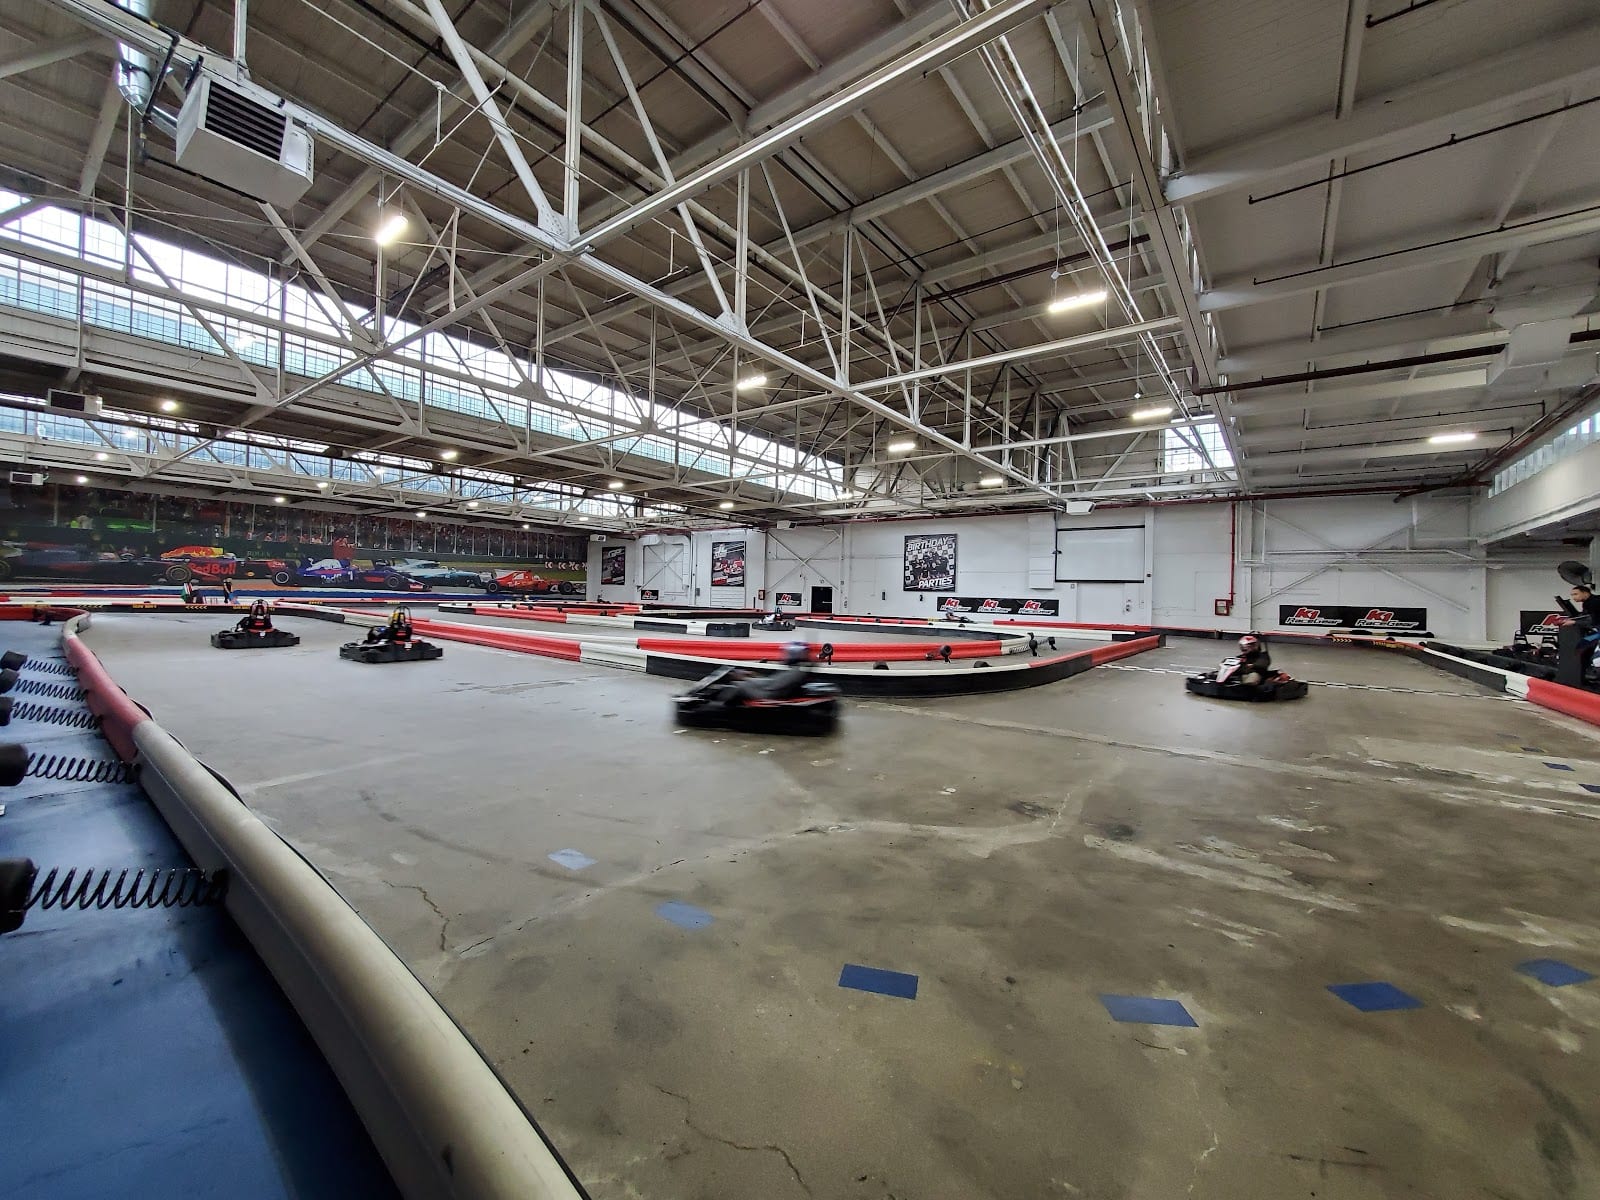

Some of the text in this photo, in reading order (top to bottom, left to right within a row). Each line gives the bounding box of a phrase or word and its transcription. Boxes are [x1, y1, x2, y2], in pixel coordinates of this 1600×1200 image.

[907, 537, 949, 551] BIRTHDAY
[918, 576, 953, 588] PARTIES
[945, 598, 960, 608] K1
[983, 599, 999, 609] K1
[1024, 600, 1041, 610] K1
[1294, 607, 1320, 621] K1
[1364, 609, 1394, 623] K1
[1355, 619, 1419, 628] RaceGear
